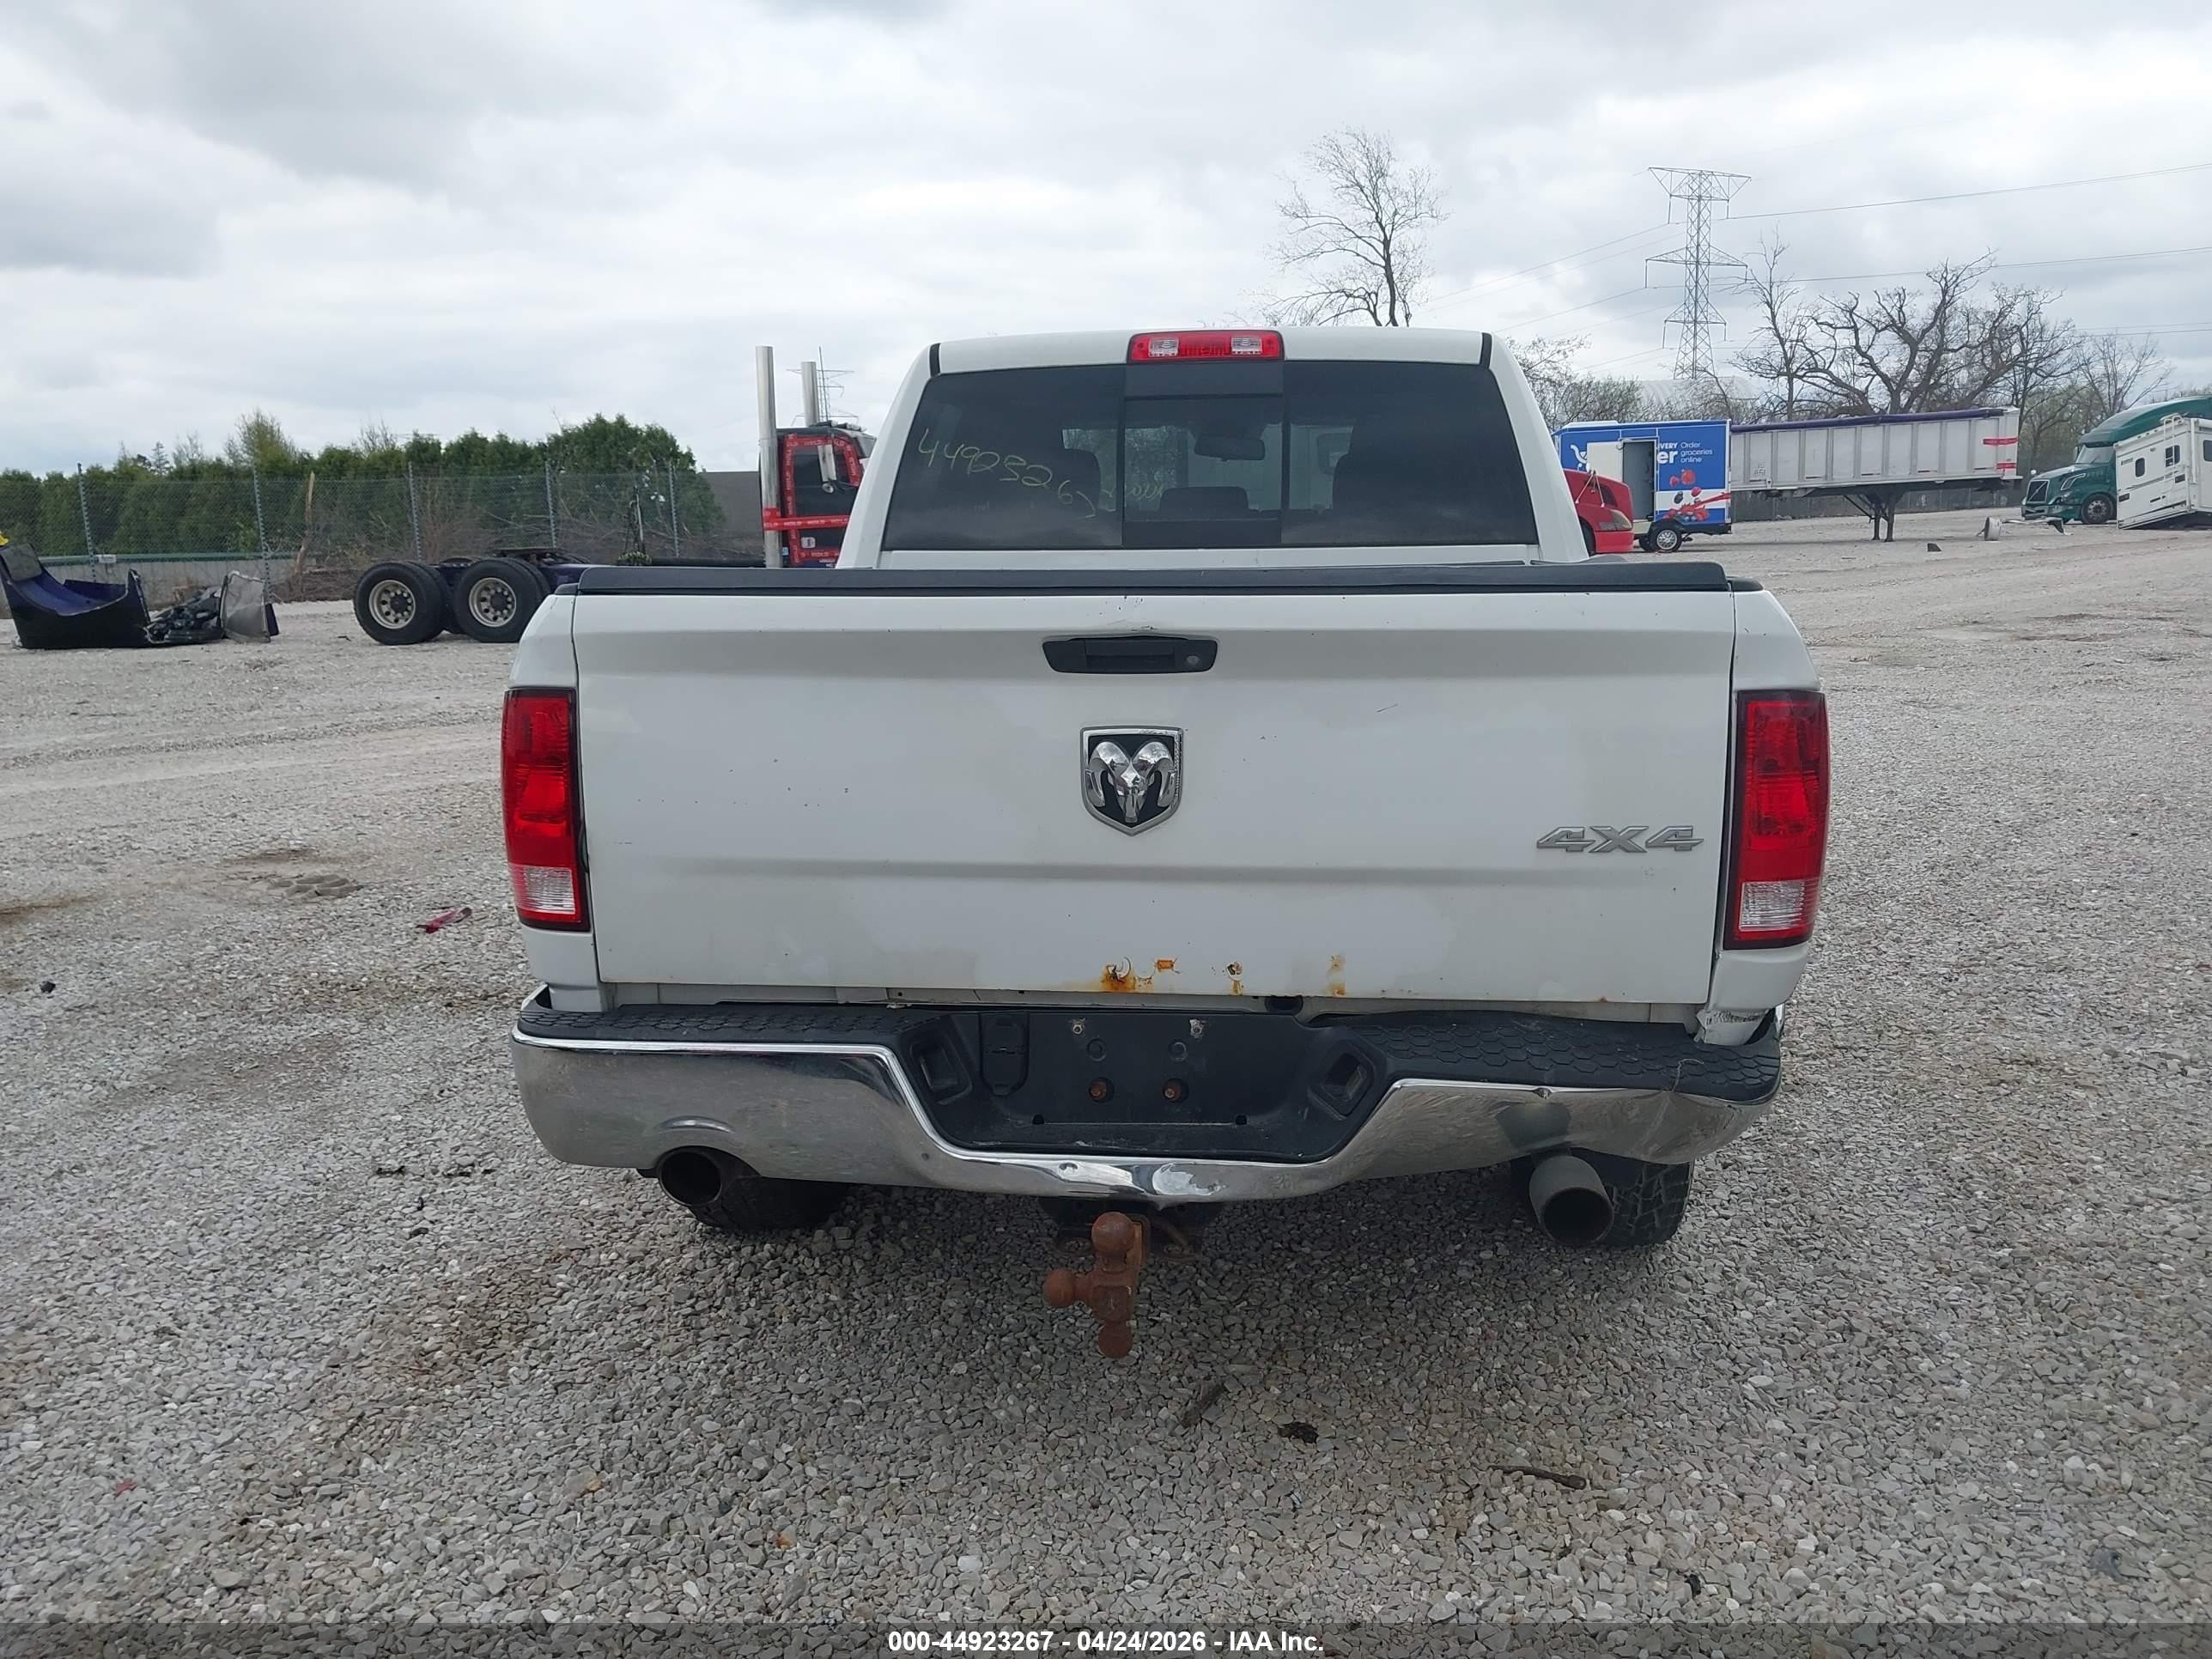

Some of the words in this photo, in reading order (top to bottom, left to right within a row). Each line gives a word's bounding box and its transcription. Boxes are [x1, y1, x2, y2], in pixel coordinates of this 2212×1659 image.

[1657, 451, 1678, 465] er
[1680, 449, 1712, 458] groceries
[1536, 825, 1705, 854] 4X4
